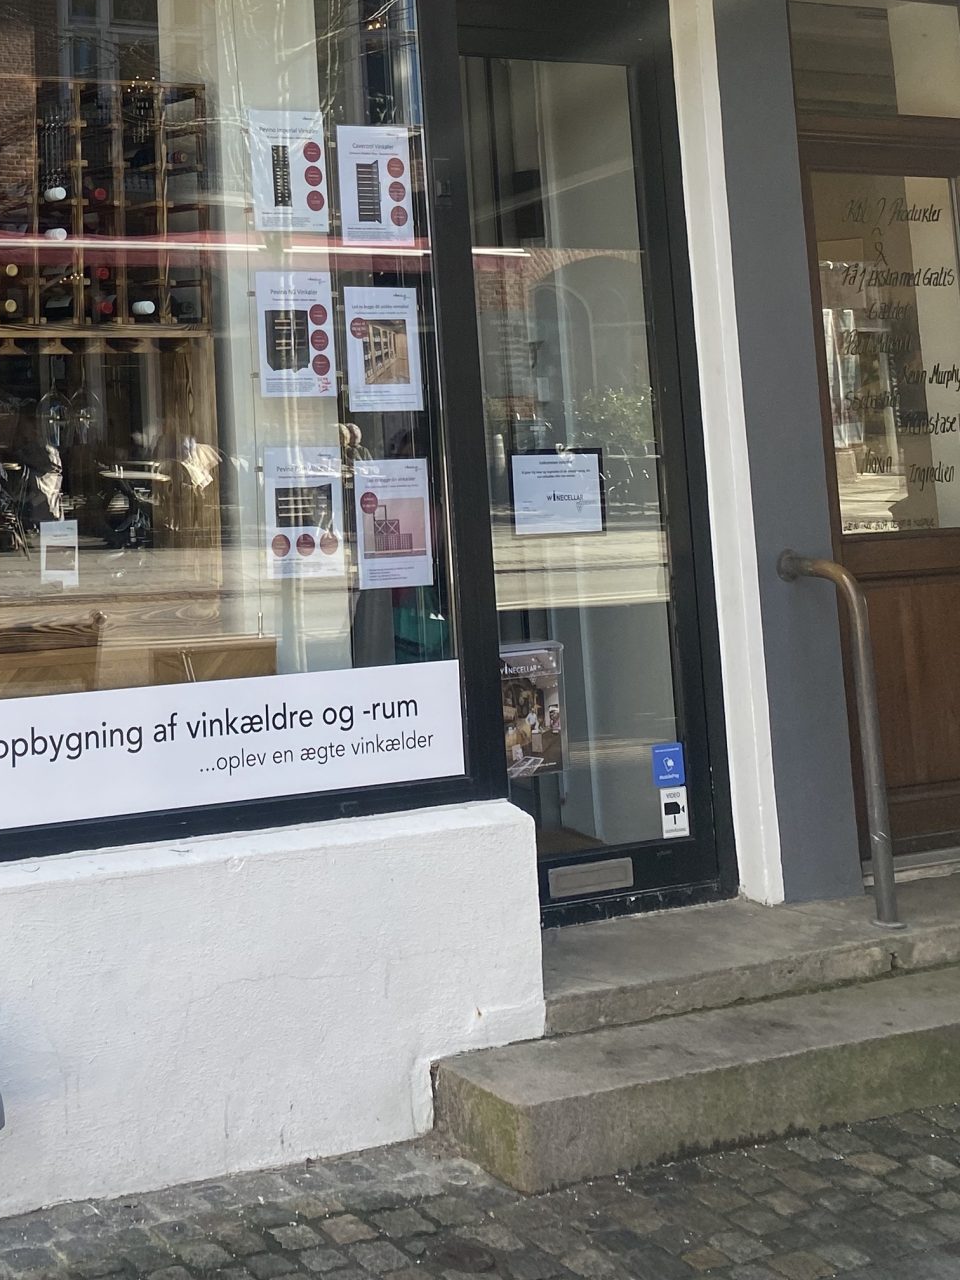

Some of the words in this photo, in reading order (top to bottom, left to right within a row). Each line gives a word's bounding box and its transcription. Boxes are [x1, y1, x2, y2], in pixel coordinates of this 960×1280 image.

[153, 711, 179, 743] af
[185, 701, 315, 740] vinkældre
[322, 705, 354, 733] og
[362, 698, 419, 722] -rum
[199, 747, 267, 777] ...oplev
[272, 749, 294, 766] en
[300, 741, 346, 766] ægte
[350, 730, 435, 757] vinkælder
